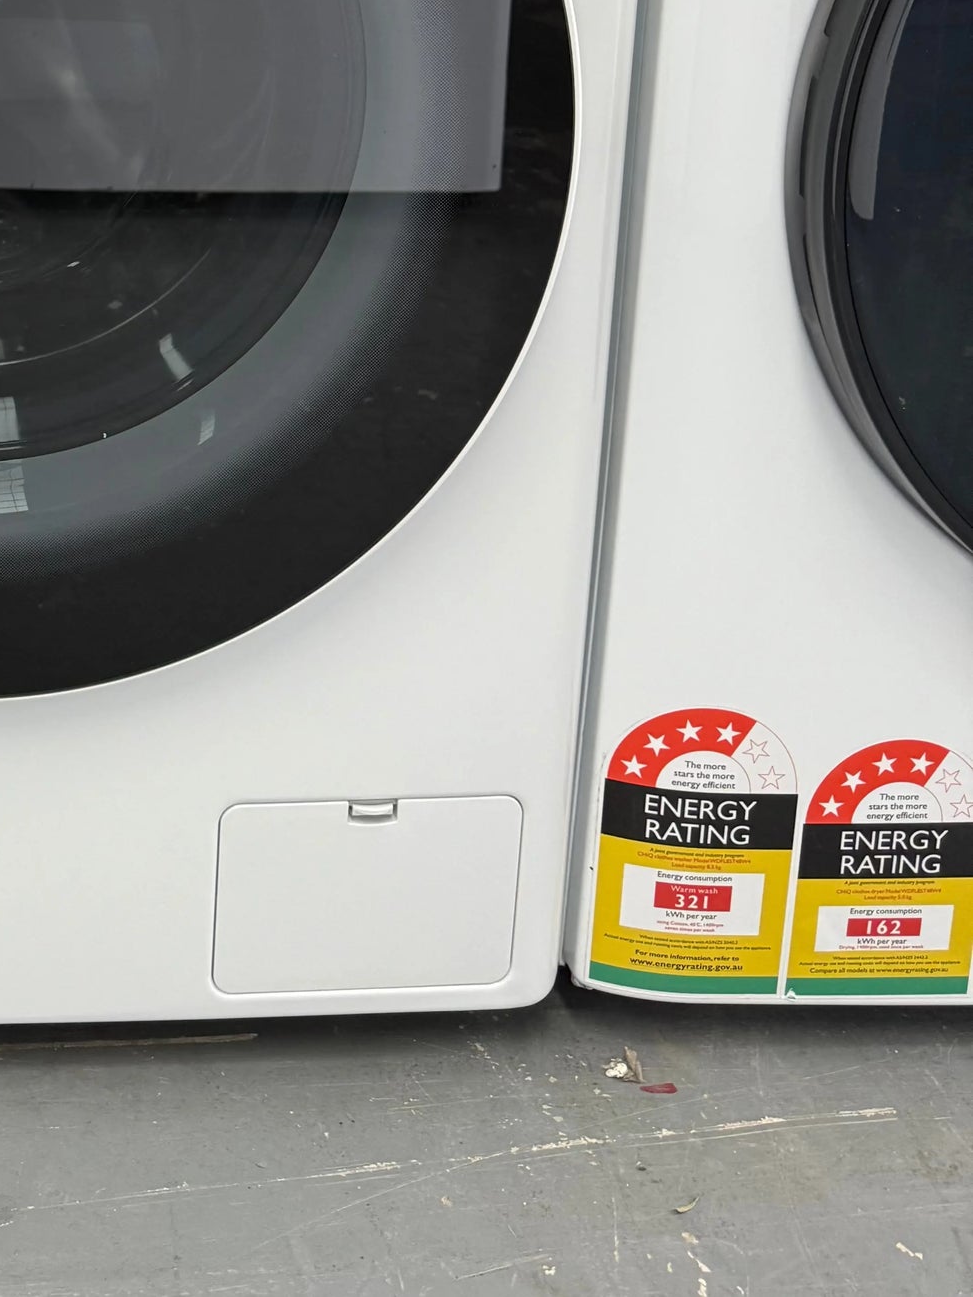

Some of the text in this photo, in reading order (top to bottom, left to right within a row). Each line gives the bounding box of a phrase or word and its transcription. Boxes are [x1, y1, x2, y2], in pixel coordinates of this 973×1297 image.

[684, 760, 702, 769] The
[673, 770, 735, 780] stars the more
[671, 780, 735, 789] energy efficient
[879, 793, 896, 801] The
[644, 793, 757, 821] ENERGY
[867, 812, 928, 821] energy efficient
[645, 818, 750, 845] RATING
[840, 830, 949, 850] ENERGY
[840, 854, 941, 875] RATING
[657, 870, 733, 882] Energy consumption
[670, 884, 718, 894] Warm wash
[674, 894, 709, 909] 321
[665, 911, 685, 919] kWh
[700, 913, 717, 921] year
[849, 907, 922, 916] Energy consumption
[866, 920, 901, 935] 162
[891, 938, 907, 946] year
[669, 953, 713, 962] information,
[630, 957, 743, 972] www.energyrating.gov.au
[809, 967, 837, 975] Compare
